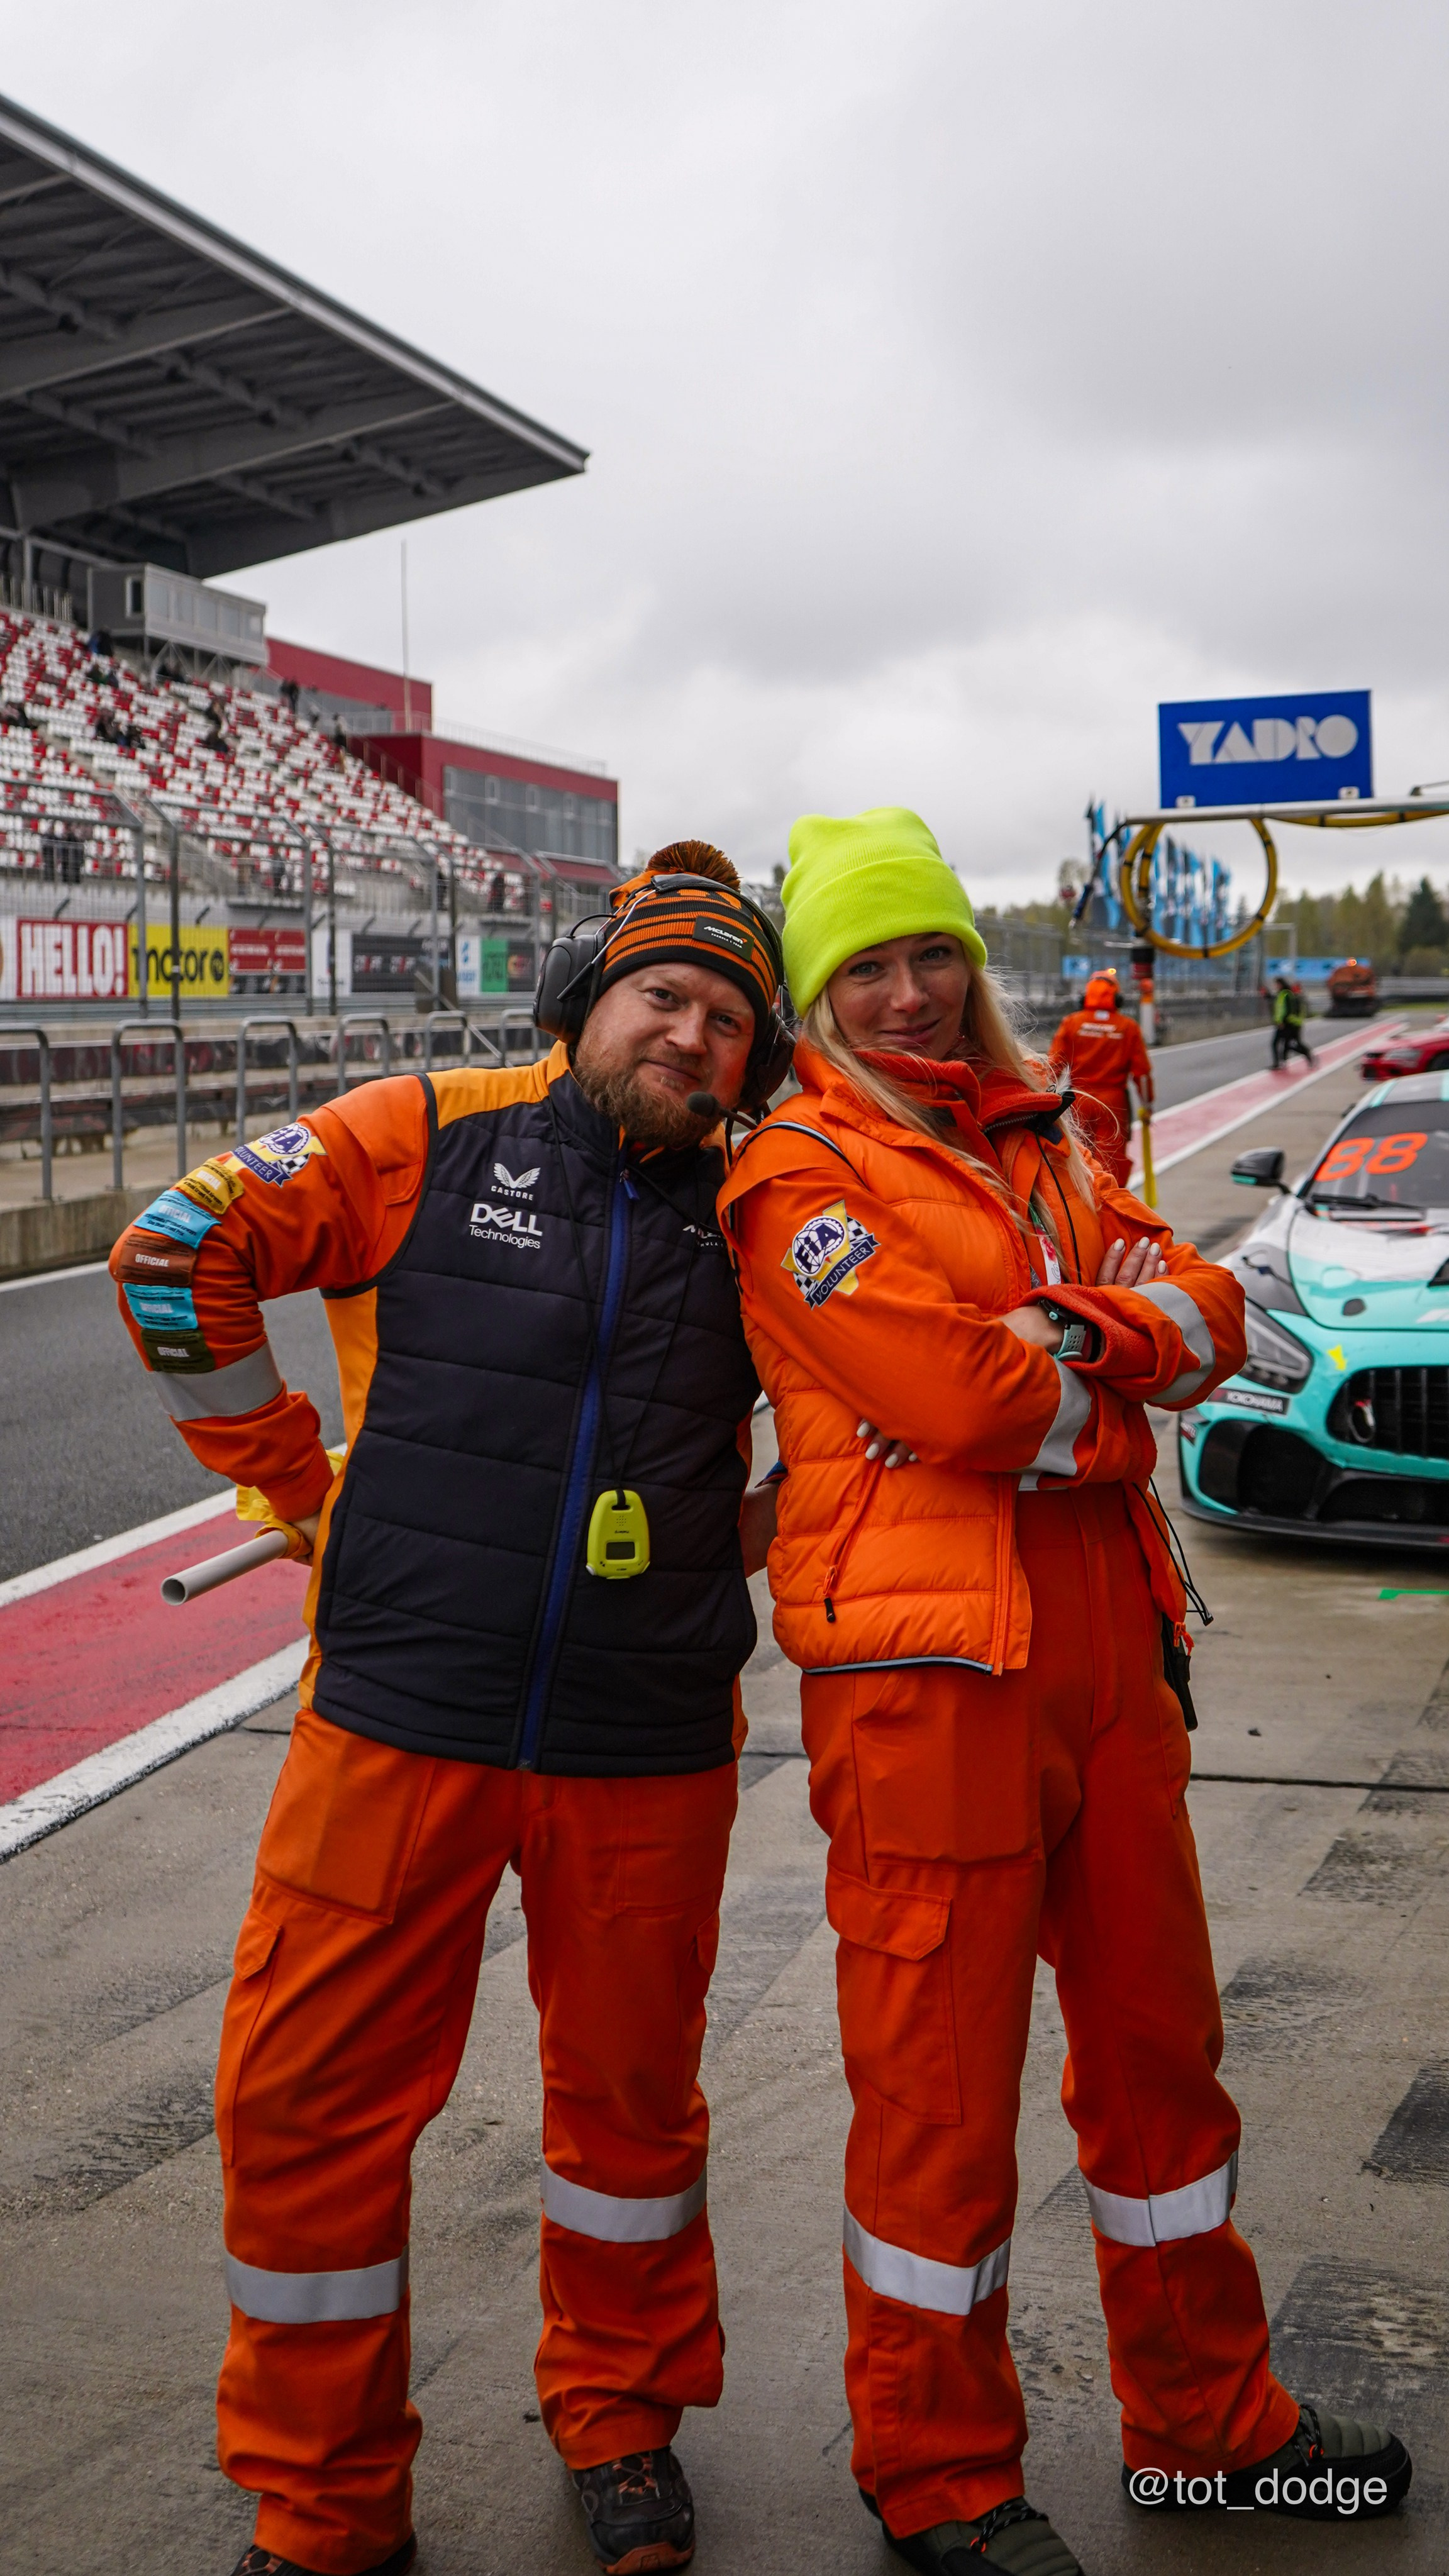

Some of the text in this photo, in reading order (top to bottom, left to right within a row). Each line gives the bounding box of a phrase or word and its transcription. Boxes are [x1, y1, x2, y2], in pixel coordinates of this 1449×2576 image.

[1177, 714, 1358, 765] YADRO
[703, 926, 743, 944] McLaren
[21, 923, 125, 997] HELLO!
[132, 948, 208, 981] moor
[236, 1145, 273, 1179] OLUNTEER
[1314, 1132, 1428, 1182] 88
[491, 1185, 534, 1201] CASTORE
[158, 1204, 191, 1223] OFFICIAL
[470, 1203, 543, 1236] DELL
[469, 1224, 541, 1249] Technologies
[794, 1223, 842, 1272] FIA
[135, 1253, 169, 1267] OFFICIAL
[816, 1246, 870, 1301] VOLUNTEER
